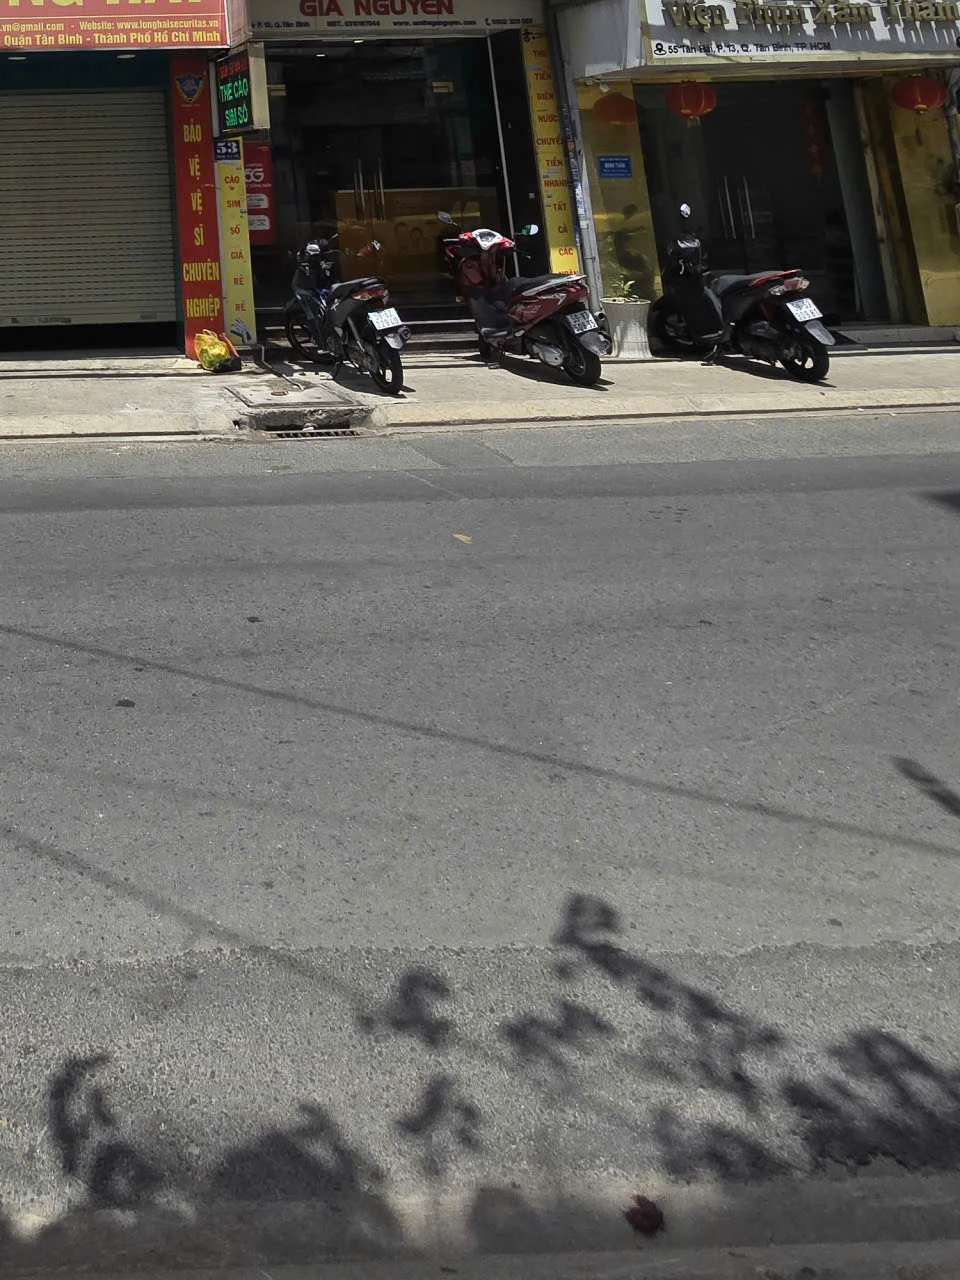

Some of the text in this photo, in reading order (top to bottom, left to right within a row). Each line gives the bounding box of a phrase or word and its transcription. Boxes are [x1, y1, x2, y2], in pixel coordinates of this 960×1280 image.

[79, 21, 115, 31] Website:
[4, 34, 32, 48] Quận
[34, 33, 51, 45] Tân
[57, 32, 83, 45] Bình
[93, 31, 127, 44] Thành
[129, 30, 151, 43] Phố
[153, 31, 168, 43] Hồ
[171, 31, 189, 42] Chí
[192, 30, 221, 42] Minh
[668, 45, 678, 54] 55
[681, 45, 697, 54] Tân
[755, 43, 770, 52] Tân
[809, 42, 832, 51] HCM
[225, 106, 238, 127] SIM
[183, 118, 202, 142] BẢO
[216, 141, 238, 155] 53
[188, 154, 201, 181] VỆ
[190, 189, 203, 215] VỆ
[226, 200, 241, 208] SIM
[194, 223, 205, 246] SĨ
[230, 224, 241, 235] SỐ
[183, 258, 220, 282] CHUYÊN
[186, 293, 220, 321] NGHIỆP
